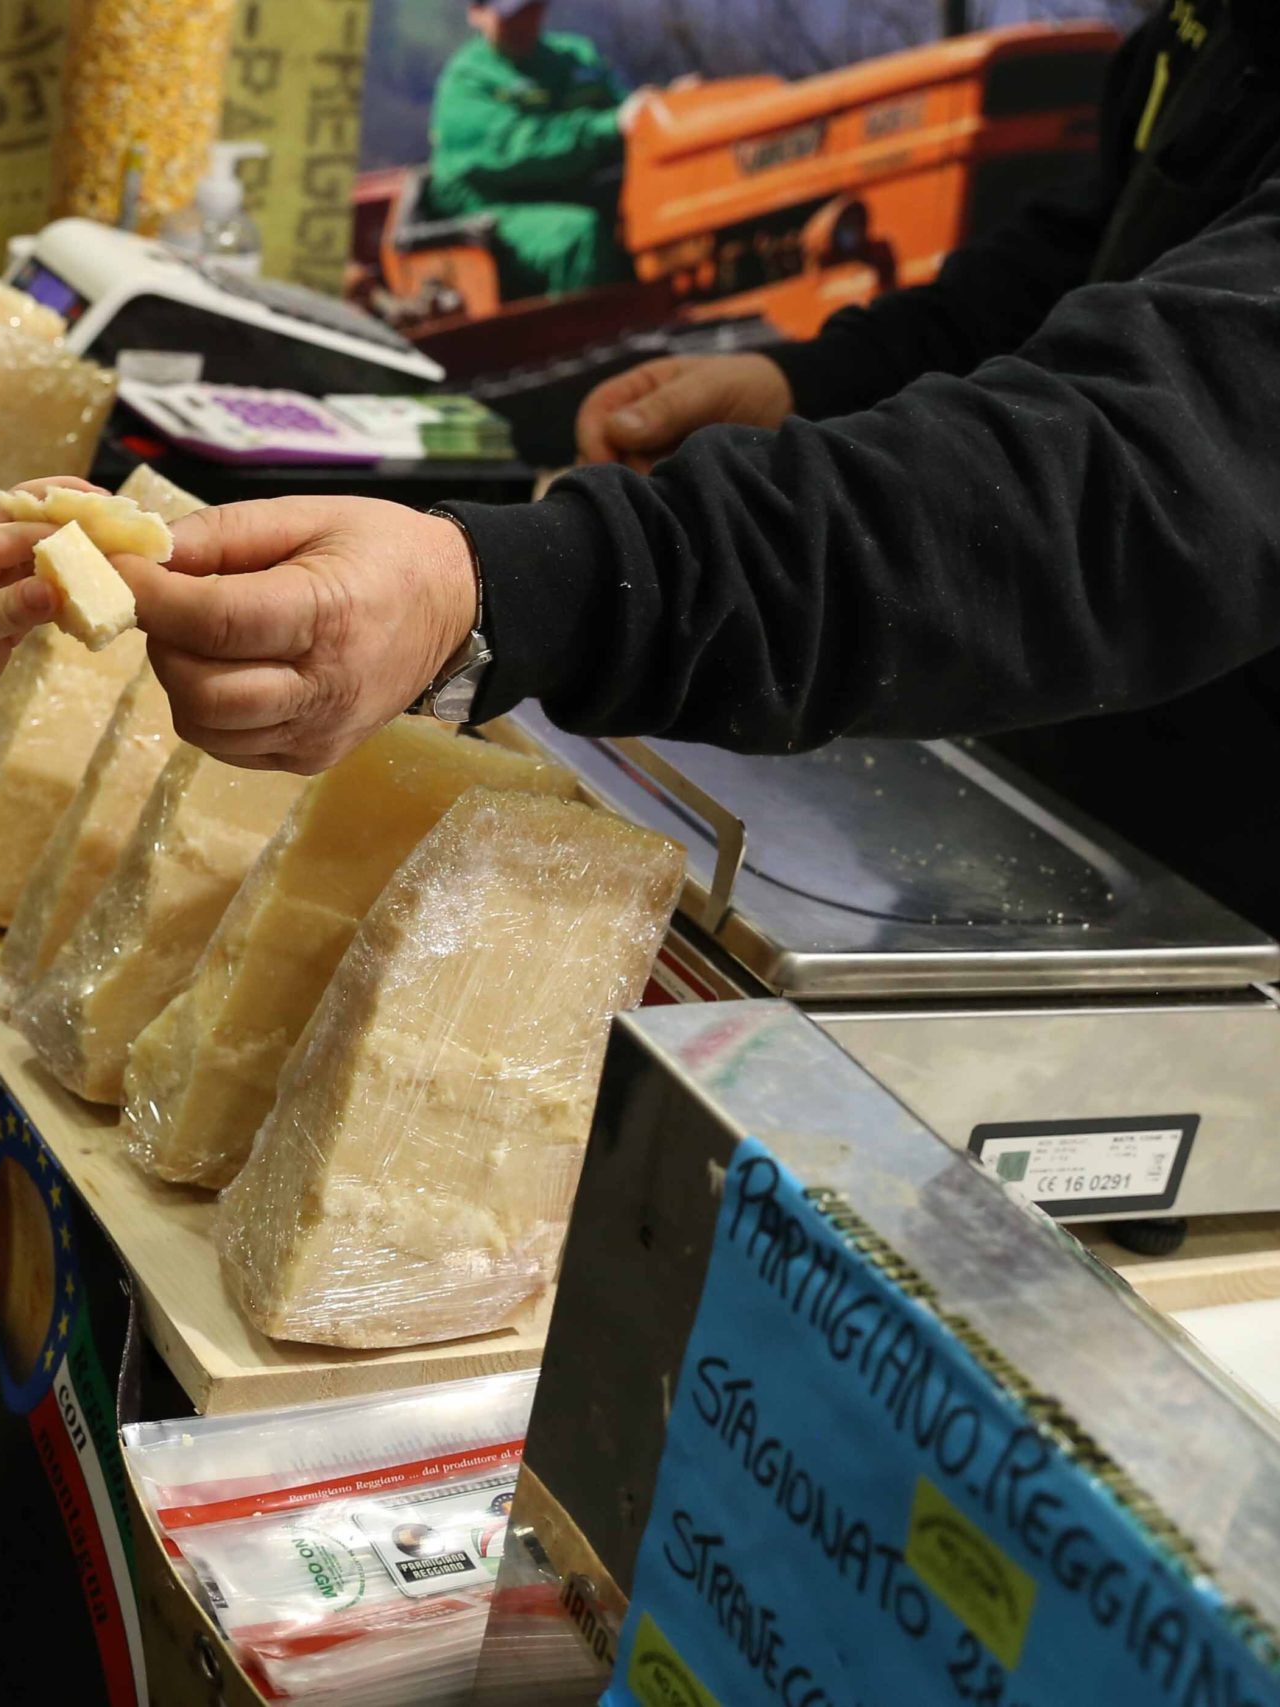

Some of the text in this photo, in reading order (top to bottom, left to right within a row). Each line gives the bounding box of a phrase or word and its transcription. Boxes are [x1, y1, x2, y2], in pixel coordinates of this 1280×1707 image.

[1064, 1175, 1084, 1192] 16
[1089, 1173, 1133, 1191] 0291
[57, 1384, 87, 1452] con
[288, 1483, 353, 1504] Parmigiano
[355, 1472, 405, 1492] Reggiano
[421, 1461, 440, 1476] dal
[442, 1451, 498, 1474] produttore
[500, 1449, 512, 1460] al
[691, 1355, 930, 1639] STAGIONATO
[38, 1422, 108, 1625] montagna
[291, 1537, 315, 1560] NO
[307, 1562, 338, 1599] OGM
[400, 1552, 467, 1573] PARMIGIANO
[412, 1562, 466, 1580] REGGIANO
[983, 1427, 1263, 1707] REGGIAN
